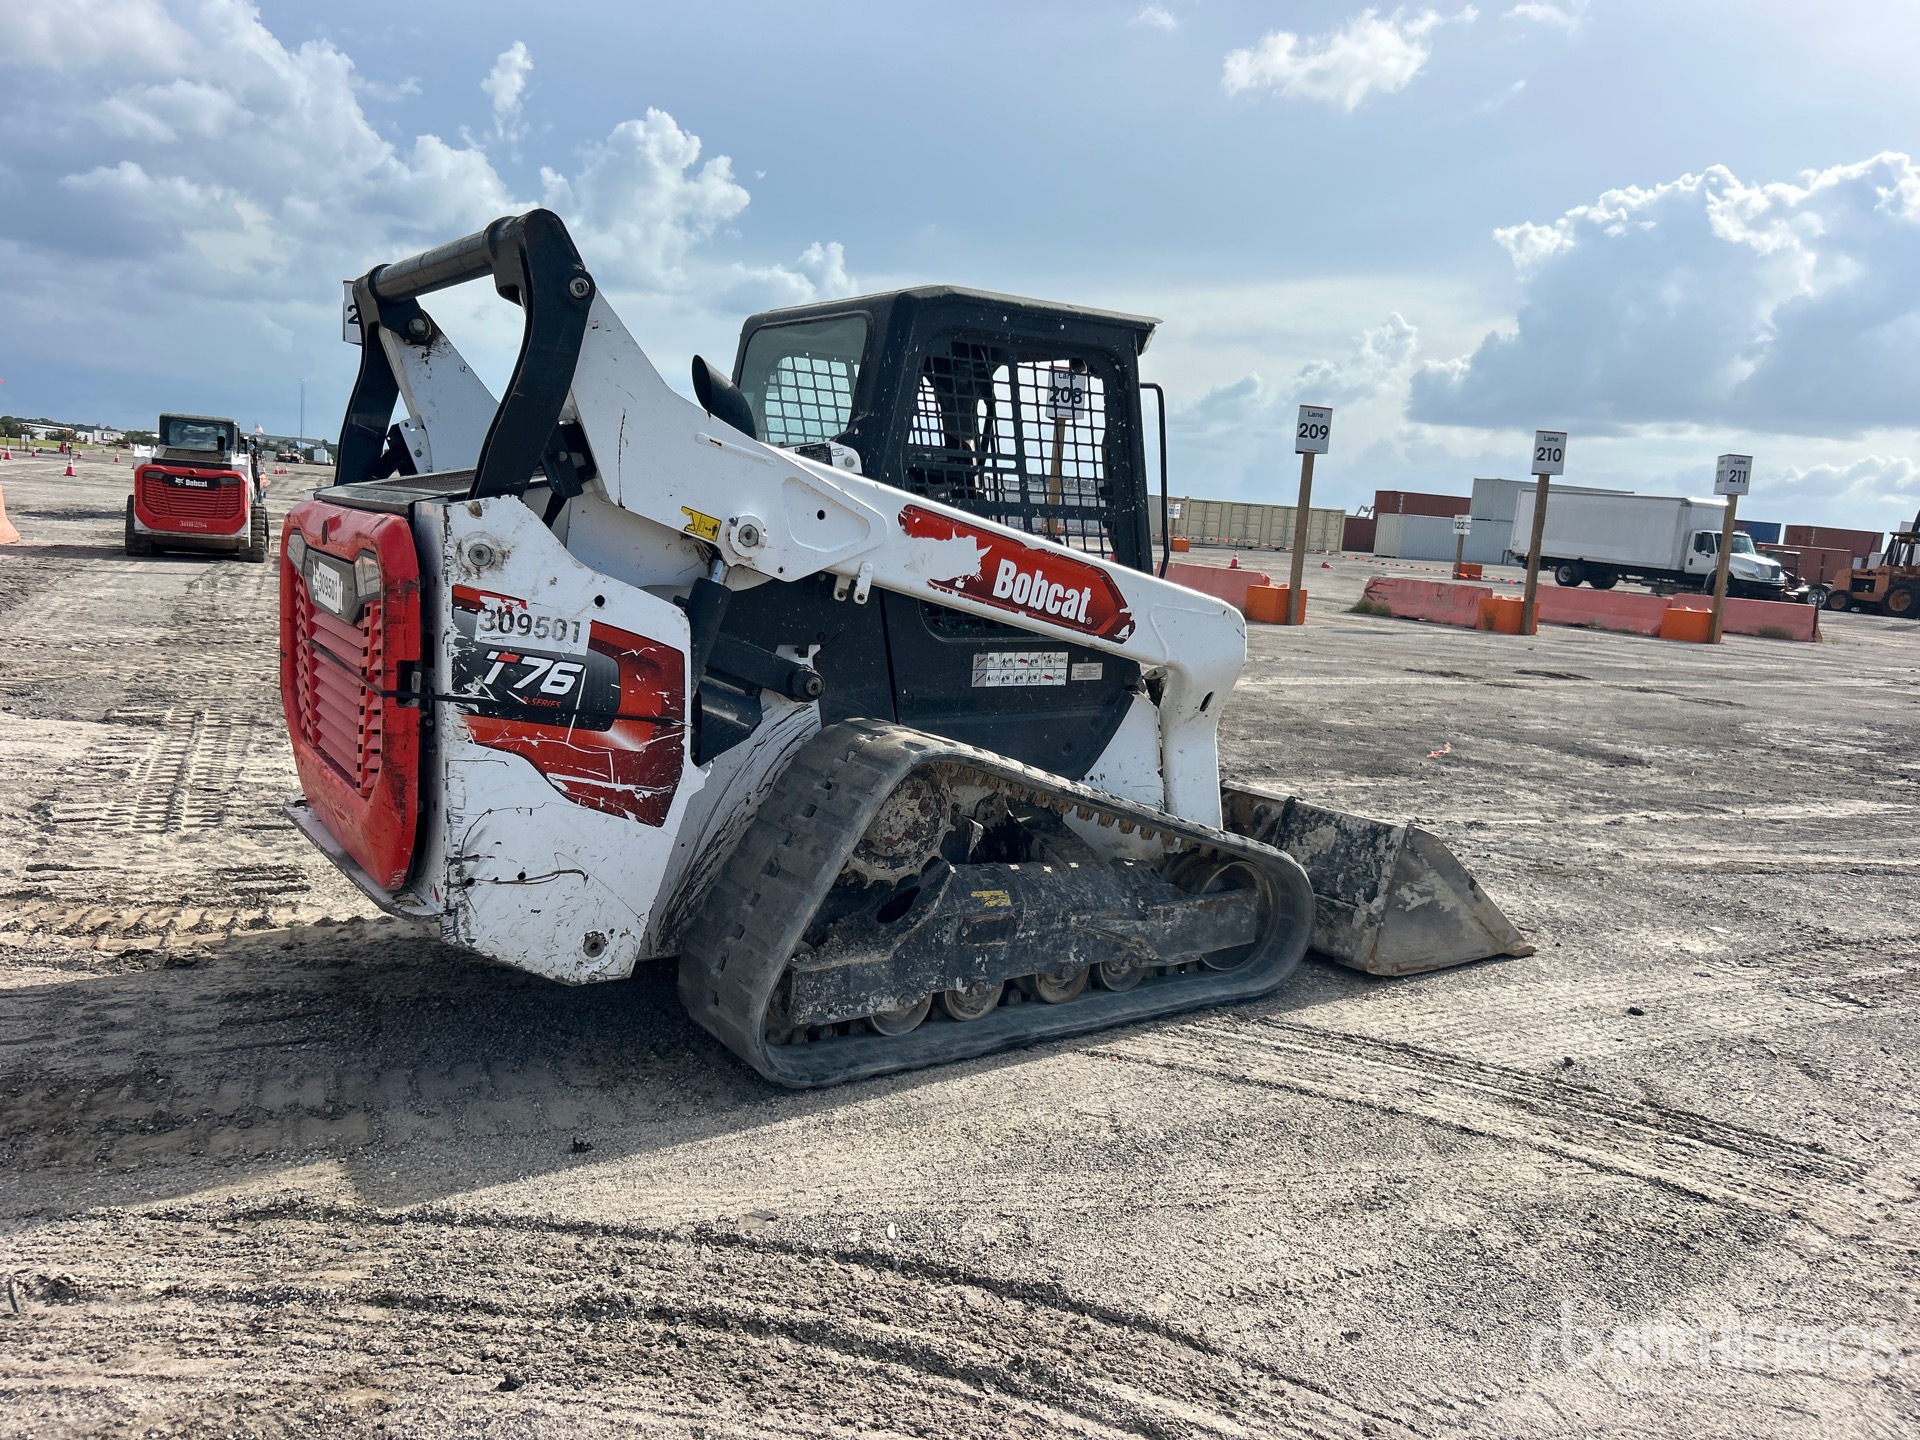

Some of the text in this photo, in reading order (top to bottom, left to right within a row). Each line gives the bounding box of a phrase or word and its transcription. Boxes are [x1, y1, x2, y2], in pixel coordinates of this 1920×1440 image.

[1049, 386, 1083, 404] 208
[1298, 422, 1329, 440] 209
[1536, 446, 1562, 462] 210
[186, 480, 208, 488] Bobcat
[1729, 470, 1747, 483] 211
[1454, 521, 1465, 530] 122
[318, 571, 338, 602] 309501
[992, 558, 1092, 624] Bobcat
[479, 609, 581, 643] 309501
[484, 650, 586, 695] T76
